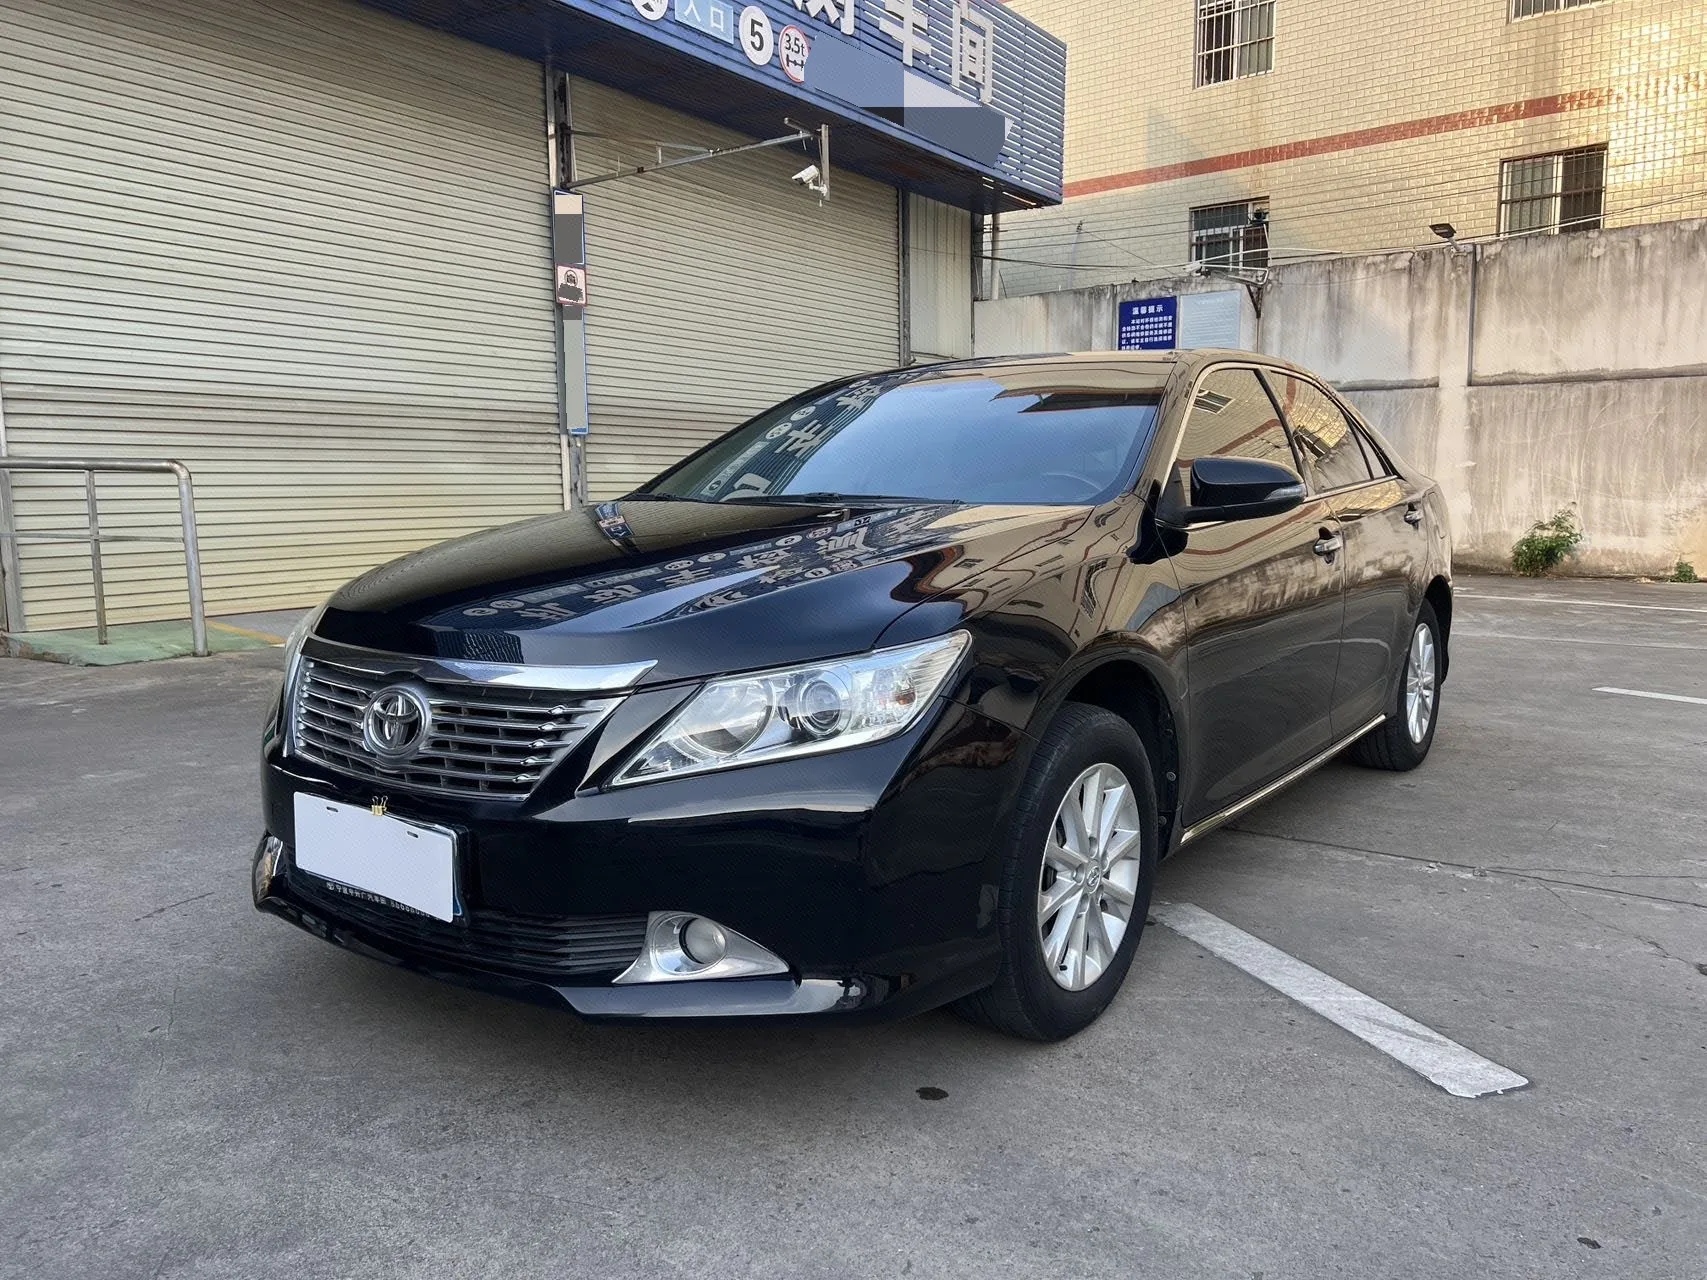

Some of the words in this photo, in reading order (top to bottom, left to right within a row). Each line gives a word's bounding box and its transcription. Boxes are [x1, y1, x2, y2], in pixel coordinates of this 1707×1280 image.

[684, 1, 725, 32] 入口
[750, 22, 765, 52] 5
[784, 33, 806, 57] 3.5t
[1132, 304, 1163, 315] 温馨提示
